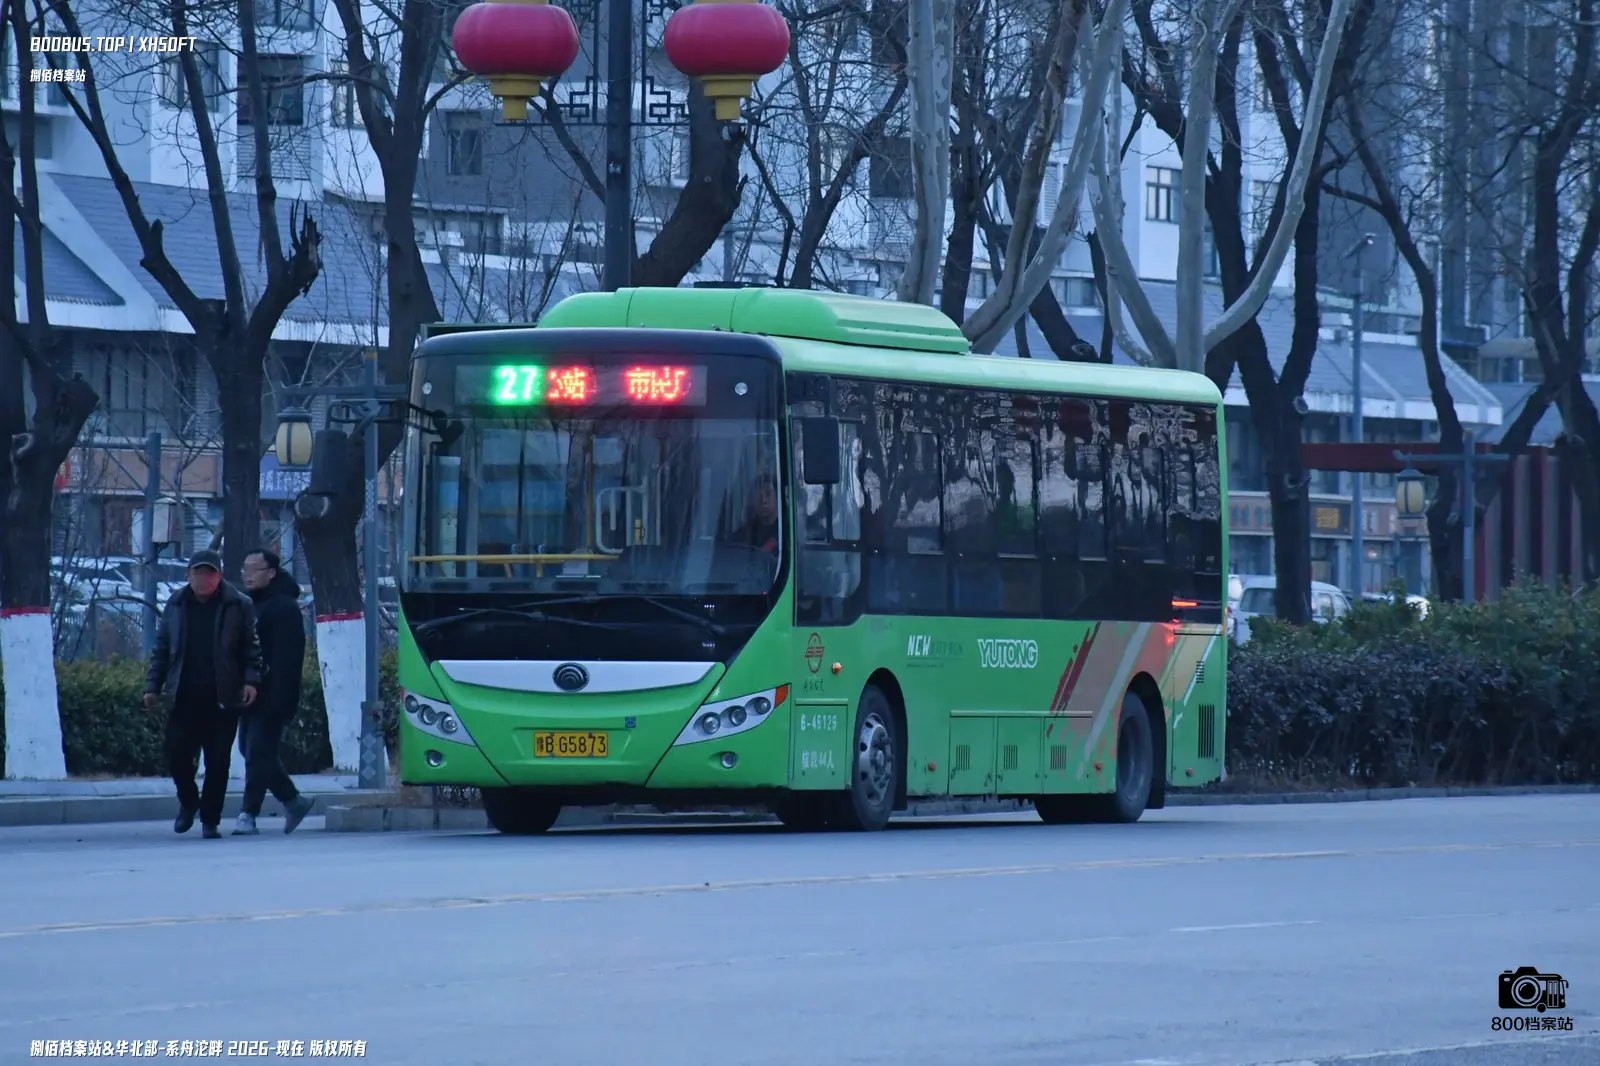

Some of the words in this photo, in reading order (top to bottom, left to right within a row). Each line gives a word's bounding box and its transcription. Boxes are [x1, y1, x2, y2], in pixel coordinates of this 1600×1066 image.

[500, 366, 537, 400] 27
[907, 635, 931, 656] NEW
[977, 638, 1038, 669] YUTONG
[559, 736, 606, 753] G5873
